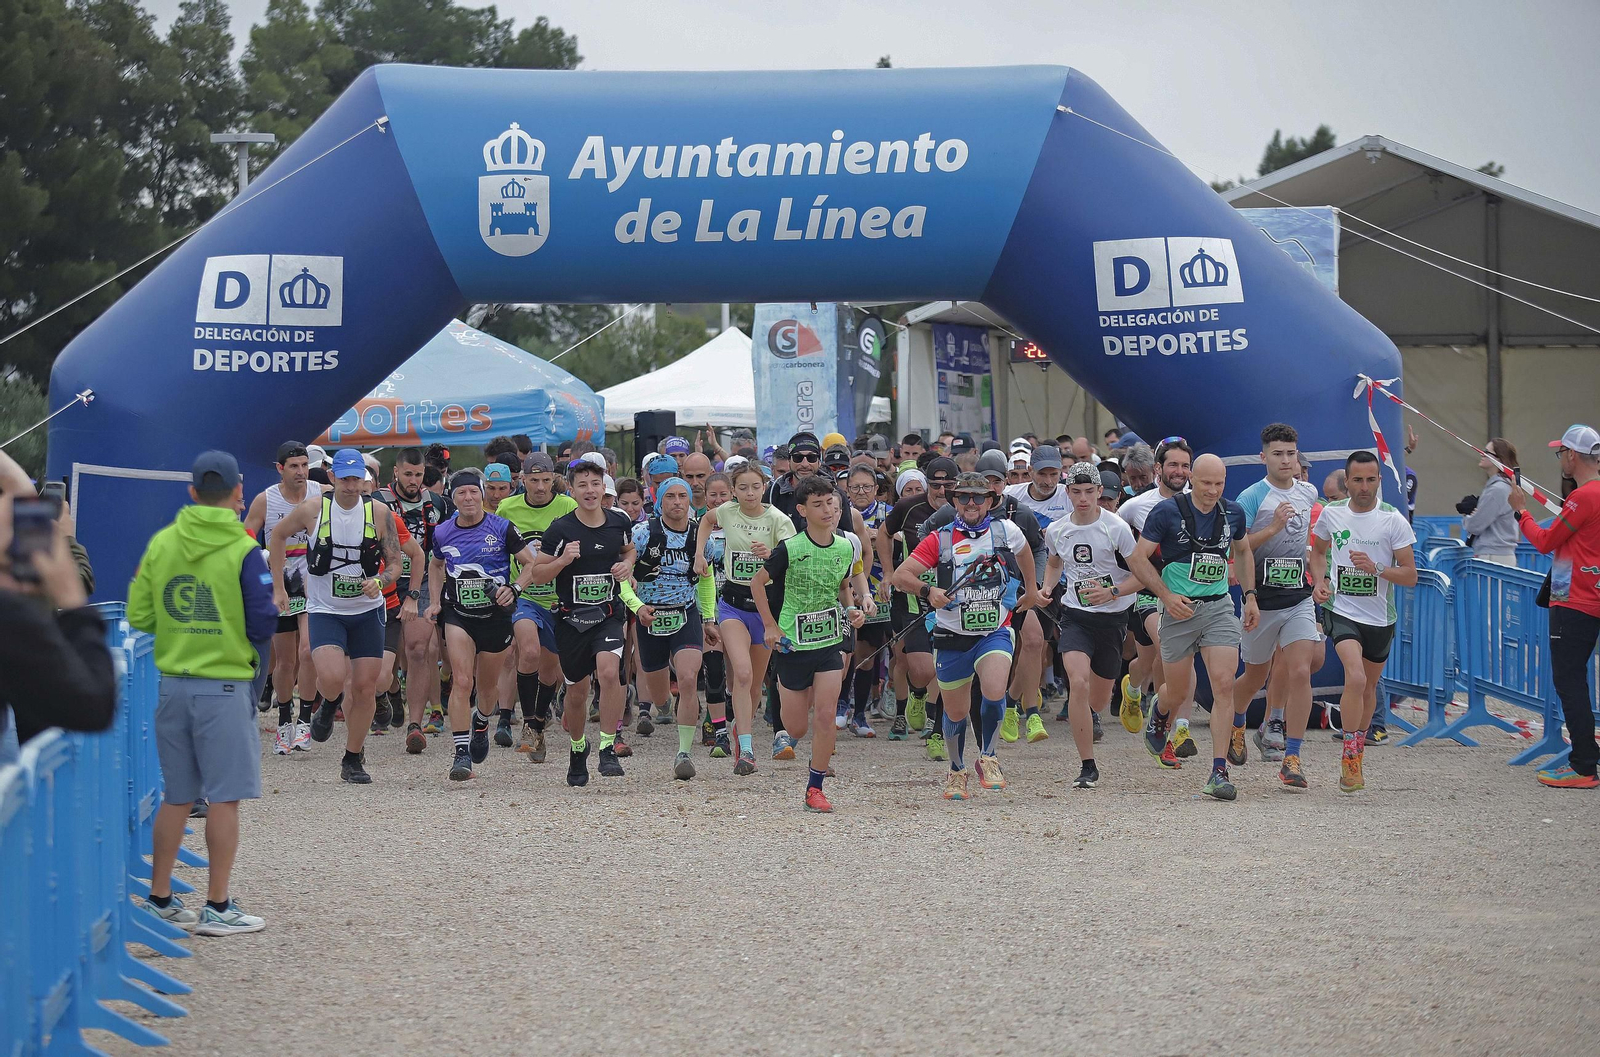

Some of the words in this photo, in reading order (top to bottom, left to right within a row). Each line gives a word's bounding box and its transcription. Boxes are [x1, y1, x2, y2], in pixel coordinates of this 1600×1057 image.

[568, 129, 968, 193] Ayuntamiento
[614, 198, 682, 243] de
[695, 199, 761, 242] La
[773, 194, 927, 241] Línea
[1112, 255, 1151, 297] D
[214, 270, 251, 310] D
[1099, 309, 1195, 327] DELEGACIÓN
[1199, 309, 1219, 322] DE
[194, 327, 290, 342] DELEGACIÓN
[294, 330, 315, 342] DE
[1102, 328, 1249, 356] DEPORTES
[193, 349, 339, 373] DEPORTES
[736, 563, 764, 573] 455
[1197, 565, 1224, 576] 406
[1271, 569, 1299, 580] 270
[1342, 576, 1373, 588] 326
[581, 585, 609, 596] 454
[654, 615, 680, 628] 367
[966, 611, 997, 624] 206
[804, 620, 832, 635] 451
